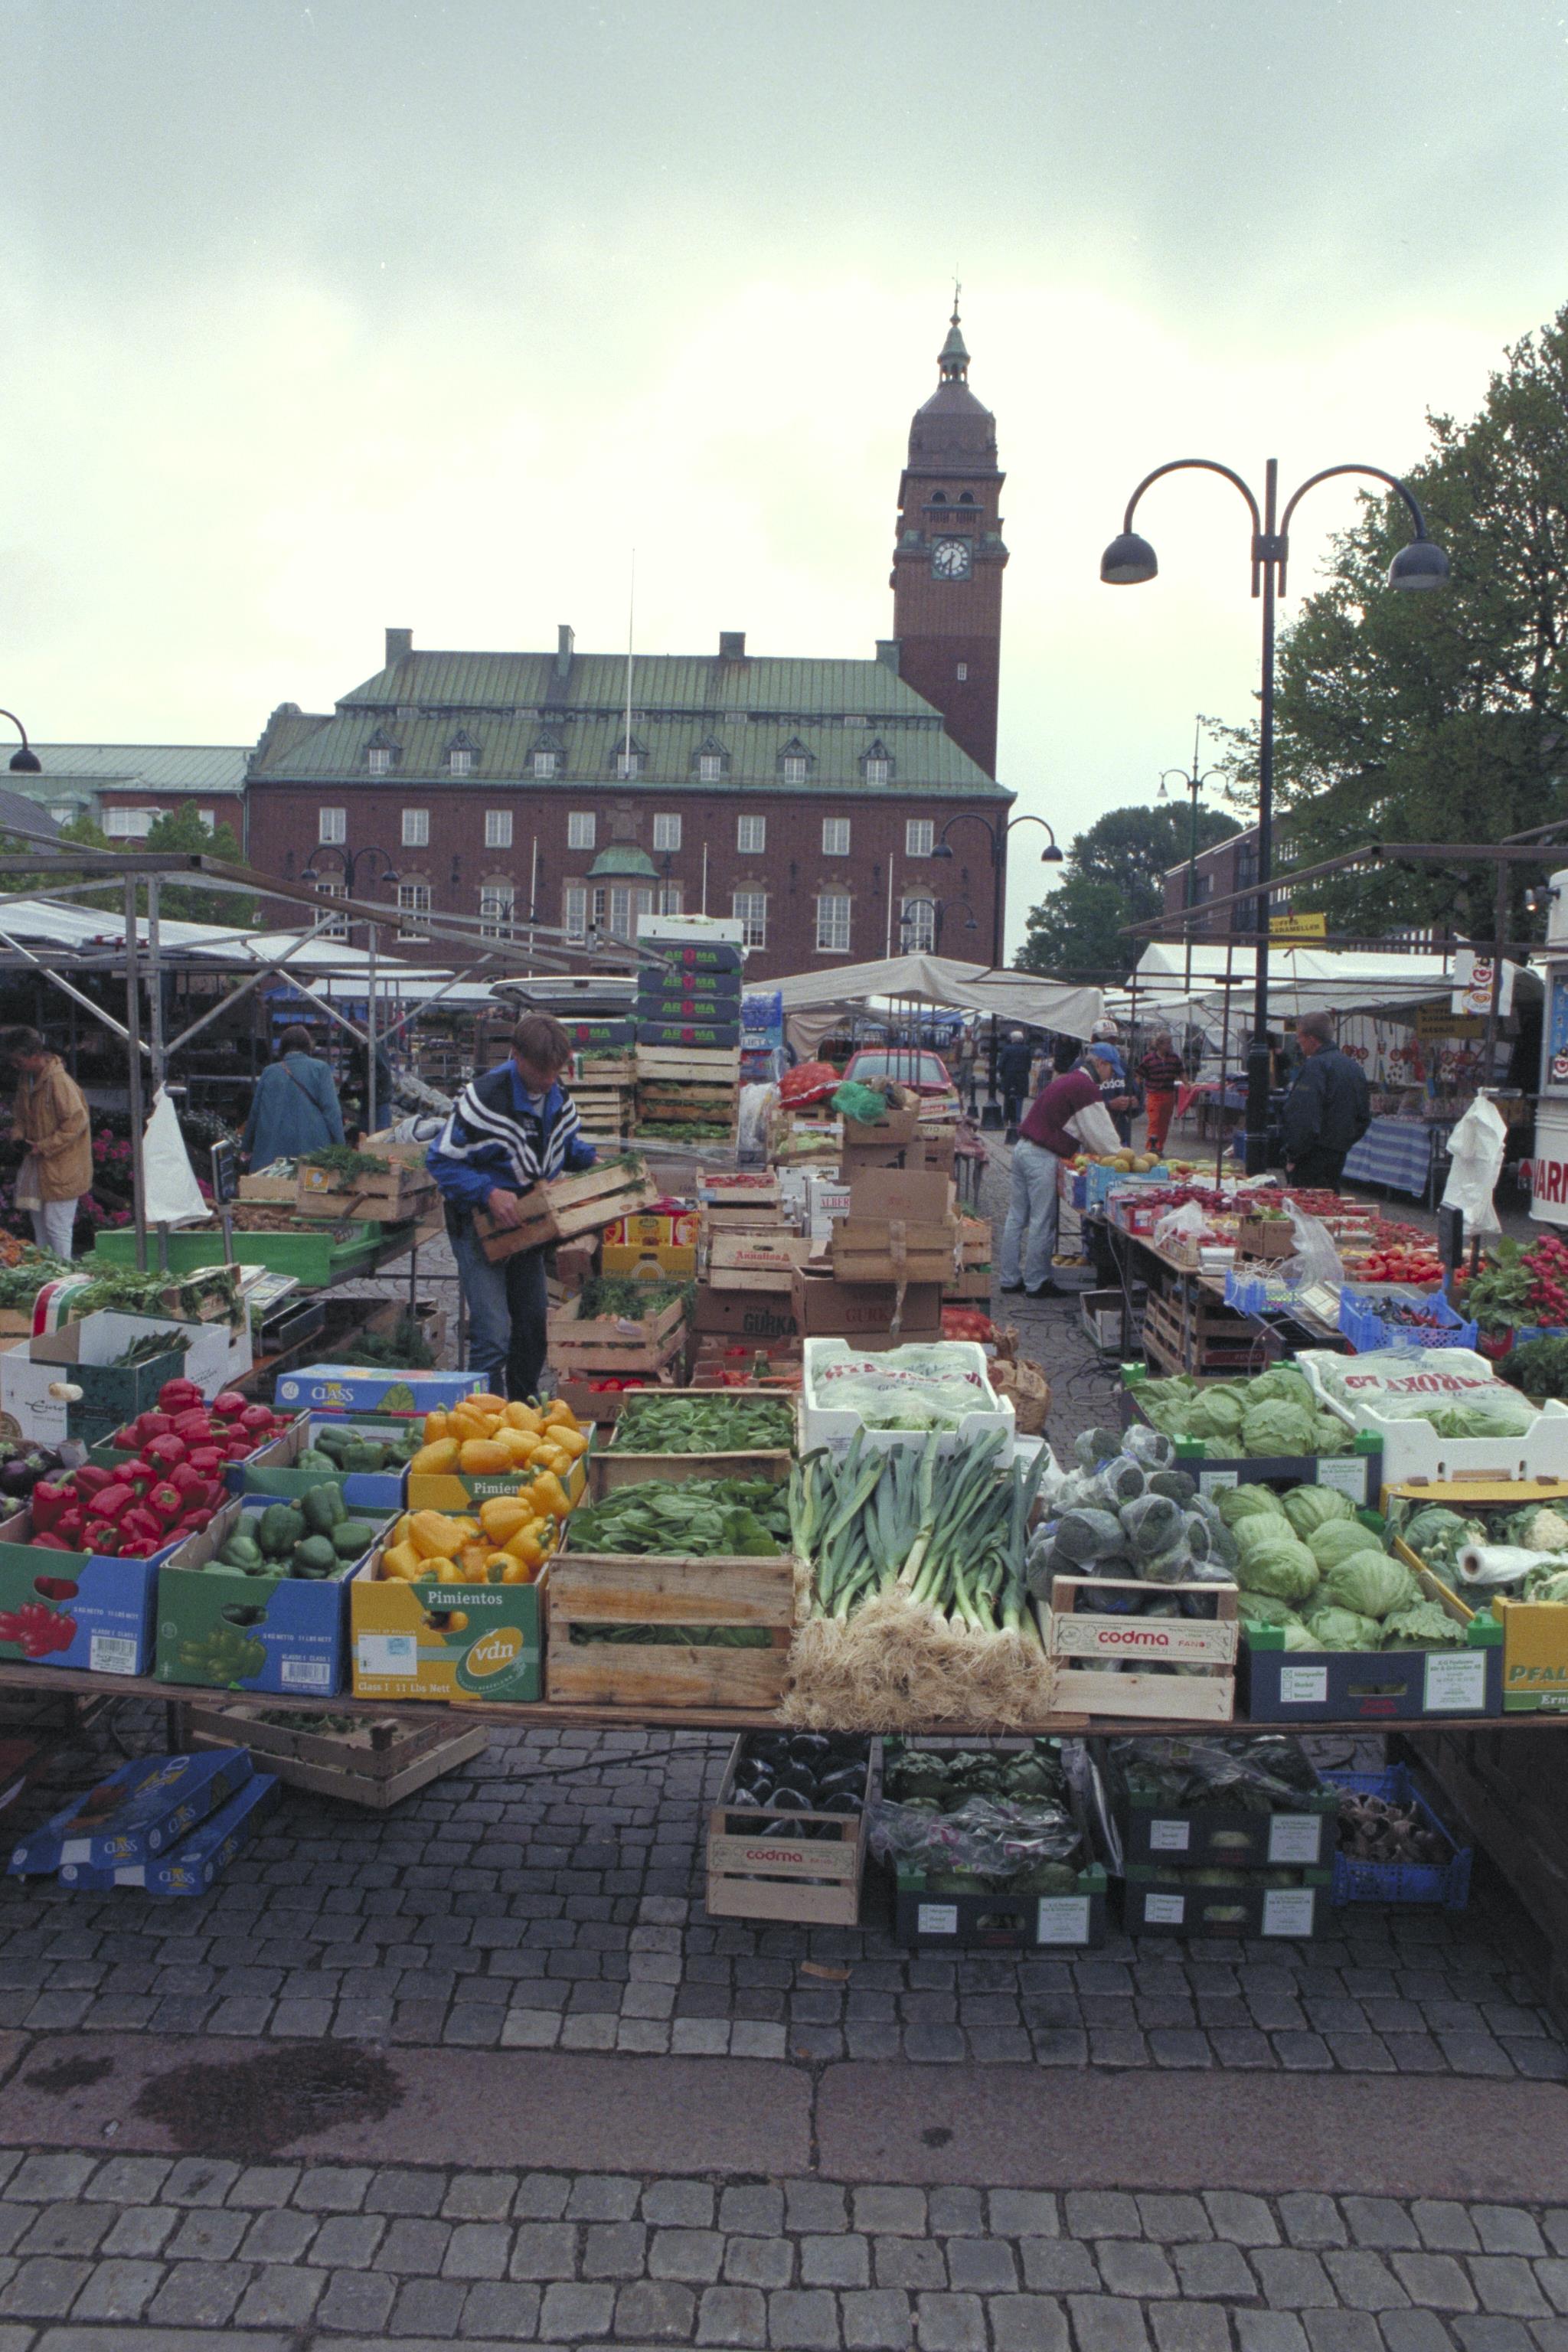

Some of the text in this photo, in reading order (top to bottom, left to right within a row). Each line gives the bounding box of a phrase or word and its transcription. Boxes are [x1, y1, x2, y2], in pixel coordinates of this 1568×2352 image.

[664, 948, 717, 964] AROMA
[662, 975, 716, 990] AROMA
[662, 1001, 715, 1017] AROMA
[568, 1024, 611, 1040] ROMA
[662, 1027, 715, 1042] AROMA
[821, 1195, 849, 1208] ALBER
[845, 1308, 894, 1323] GURK
[743, 1313, 797, 1335] GURKA
[312, 1387, 354, 1402] CLASS
[25, 1400, 65, 1413] Euro
[473, 1481, 520, 1494] Pimien
[428, 1591, 503, 1605] Pimientos
[1098, 1630, 1169, 1646] codma
[475, 1641, 514, 1661] vdn
[358, 1682, 381, 1691] Class
[410, 1684, 426, 1693] Lbs
[430, 1684, 450, 1693] Nett
[104, 1840, 138, 1854] CLASS
[746, 1849, 803, 1863] codma
[159, 1870, 196, 1884] CLASS
